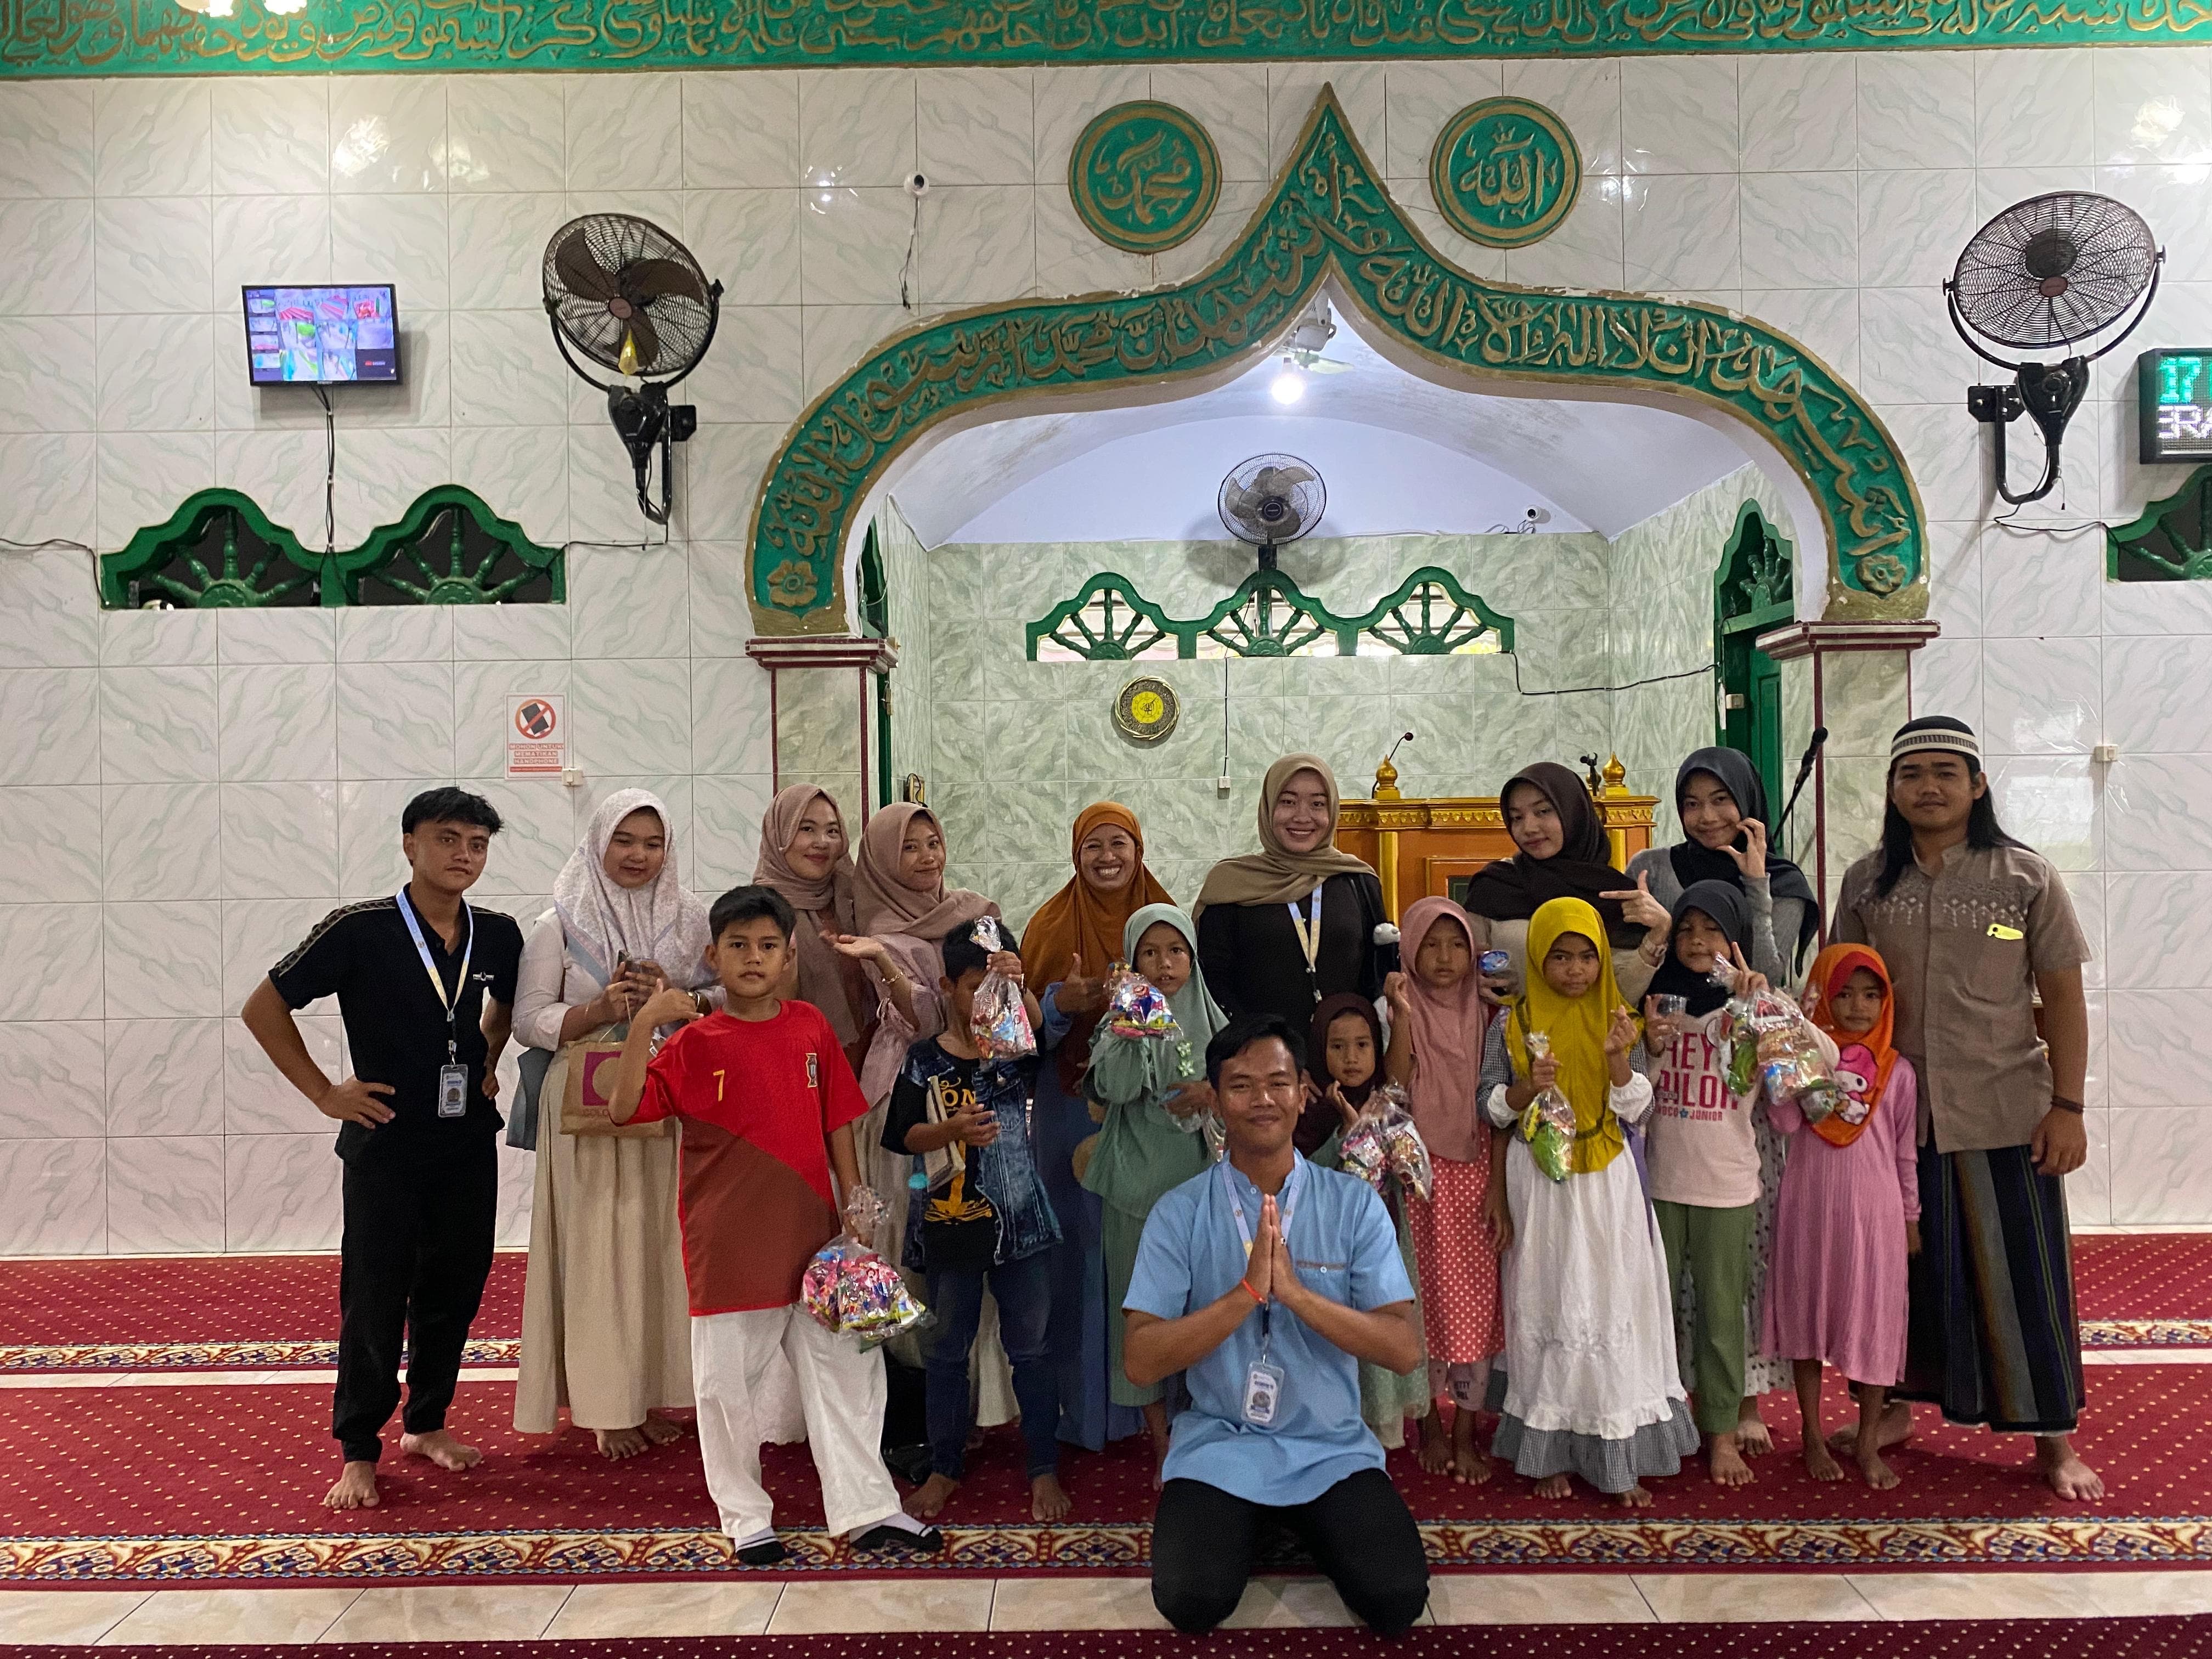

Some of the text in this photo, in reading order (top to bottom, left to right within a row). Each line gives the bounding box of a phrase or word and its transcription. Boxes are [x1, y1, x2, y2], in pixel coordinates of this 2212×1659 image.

[1460, 137, 1550, 218] الله
[712, 1068, 726, 1102] 7
[1689, 1109, 1723, 1122] JUNIOR
